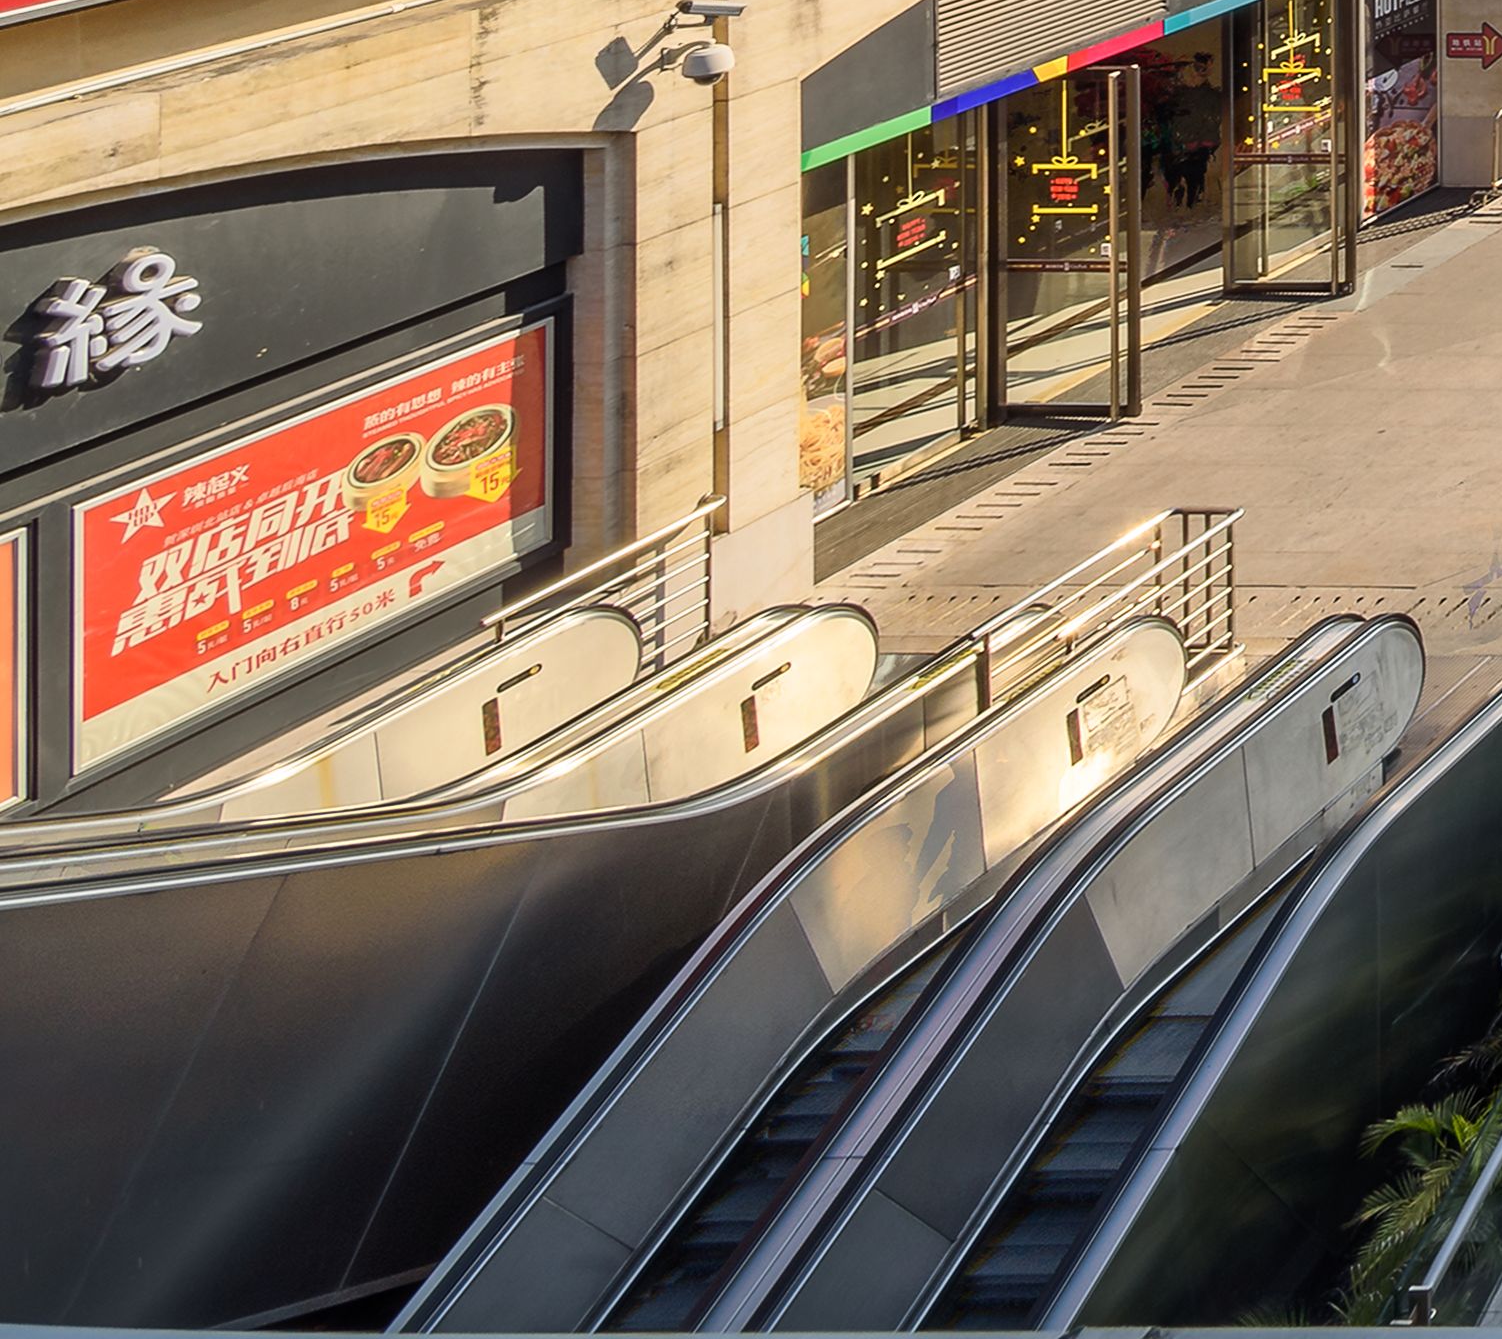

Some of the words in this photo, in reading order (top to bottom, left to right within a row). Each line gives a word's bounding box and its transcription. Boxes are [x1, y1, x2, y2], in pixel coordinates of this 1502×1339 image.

[364, 388, 443, 430] 蒸的有思想
[182, 463, 250, 507] 辣起义
[111, 509, 356, 658] 惠战到底
[133, 472, 350, 606] 双店同开
[207, 588, 397, 694] 入门向右直行50米
